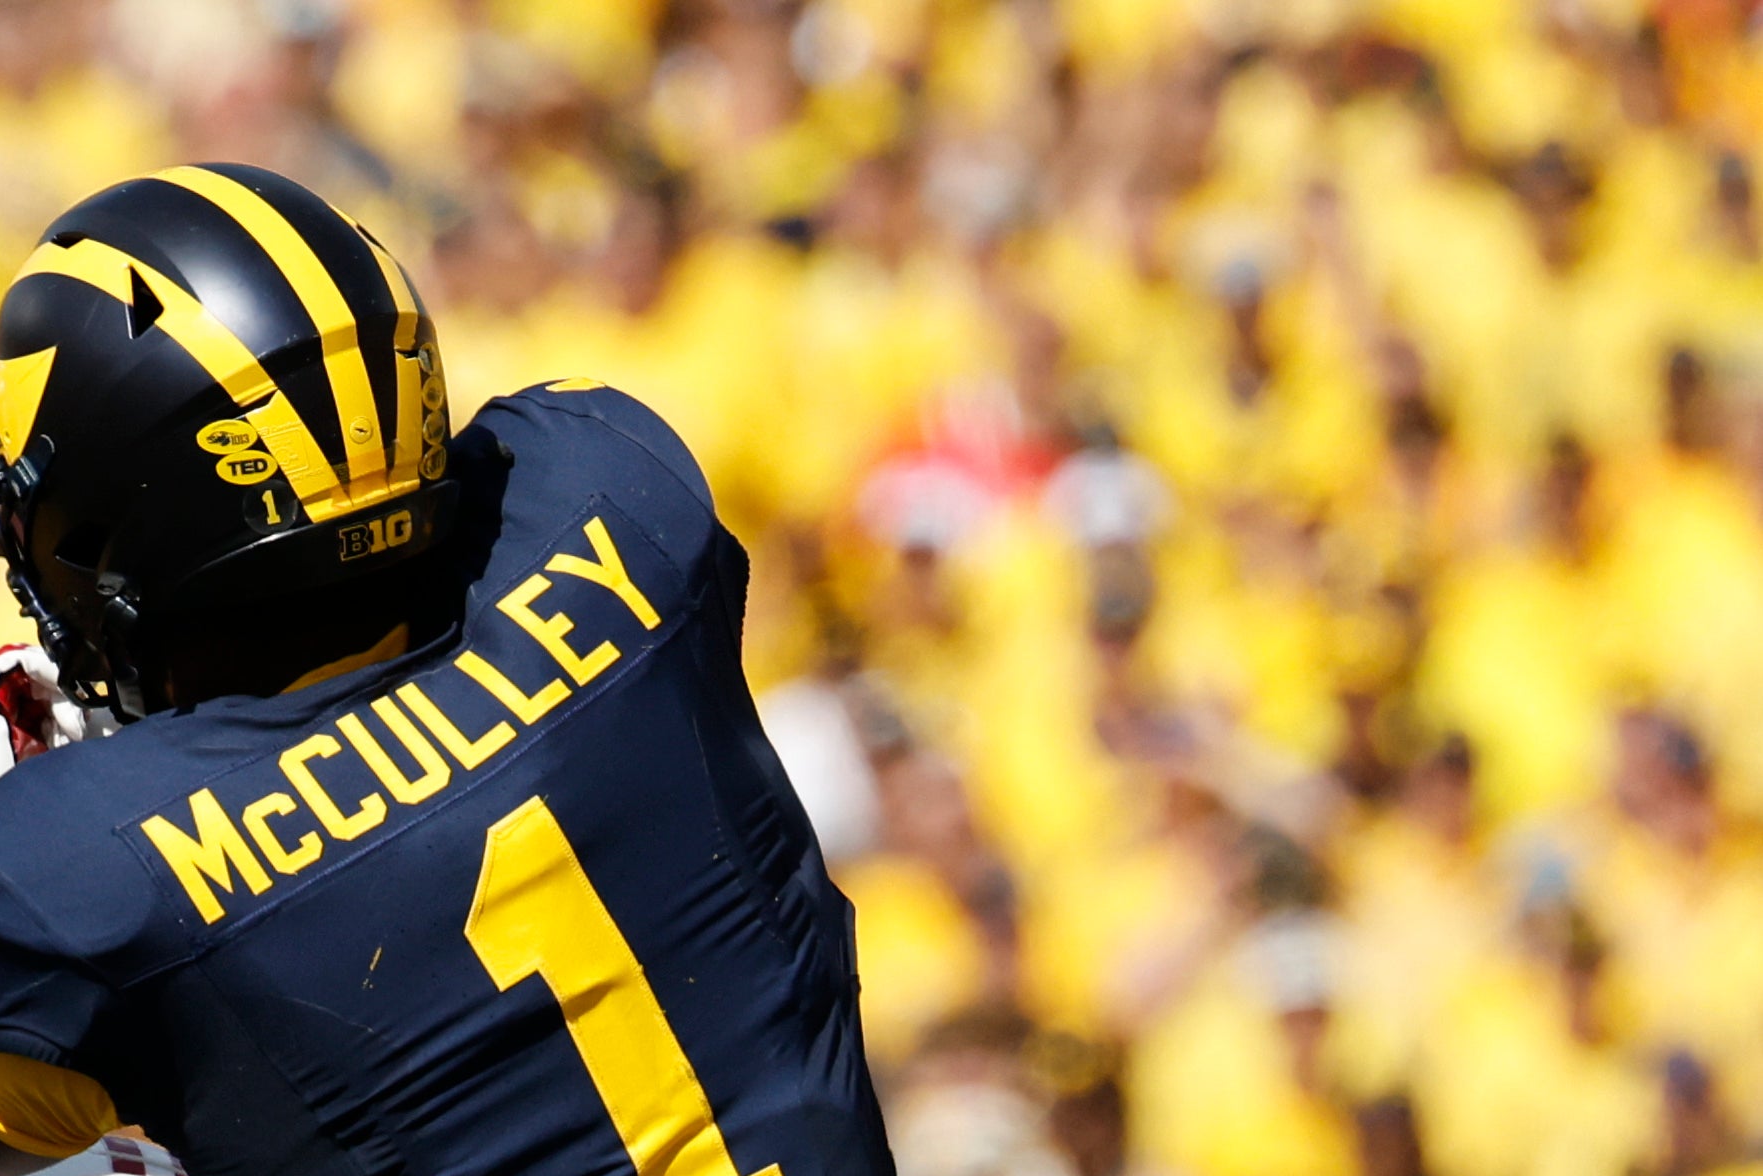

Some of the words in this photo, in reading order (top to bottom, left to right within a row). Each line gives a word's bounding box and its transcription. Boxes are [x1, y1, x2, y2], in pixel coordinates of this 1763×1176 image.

[226, 458, 268, 476] TED
[261, 489, 281, 525] 1
[140, 516, 662, 926] McCULLEY
